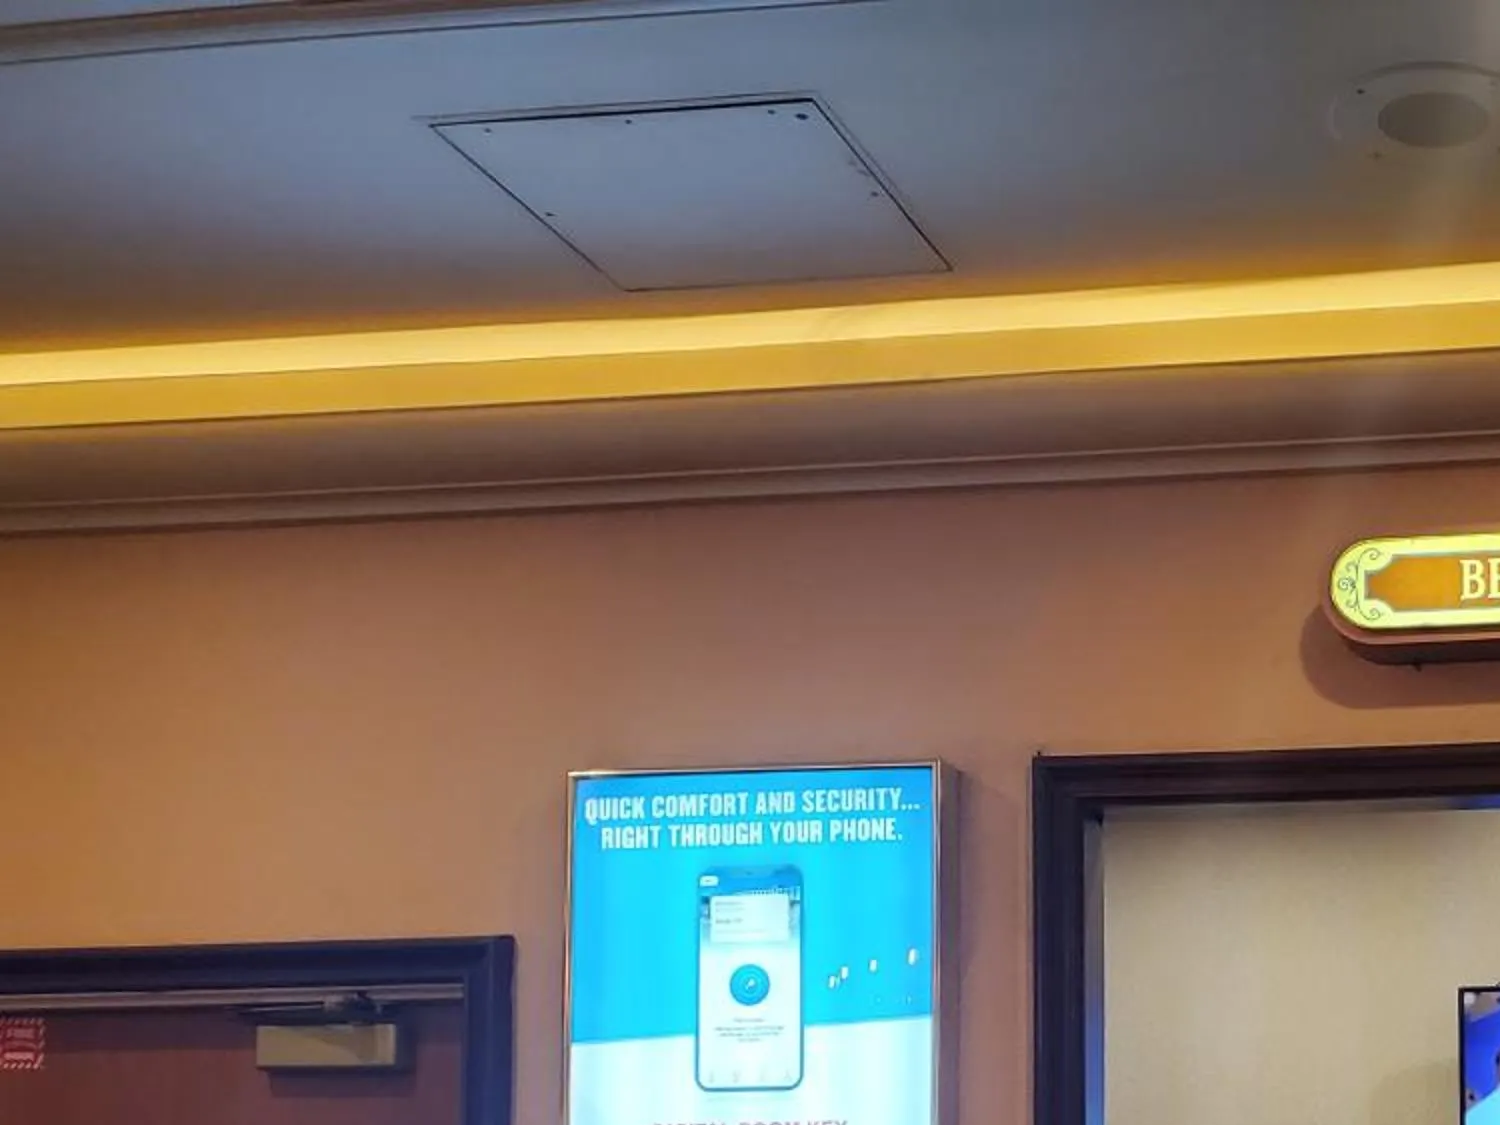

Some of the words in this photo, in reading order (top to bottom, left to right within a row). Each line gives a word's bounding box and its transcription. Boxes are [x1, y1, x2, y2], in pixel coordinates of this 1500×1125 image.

[584, 797, 646, 826] QUICK
[651, 793, 749, 819] COMFORT
[755, 791, 796, 815] AND
[801, 787, 921, 814] SECURITY...
[601, 825, 662, 849] RIGHT
[668, 821, 764, 848] THROUGH
[769, 819, 824, 844] YOUR
[829, 817, 903, 843] PHONE.
